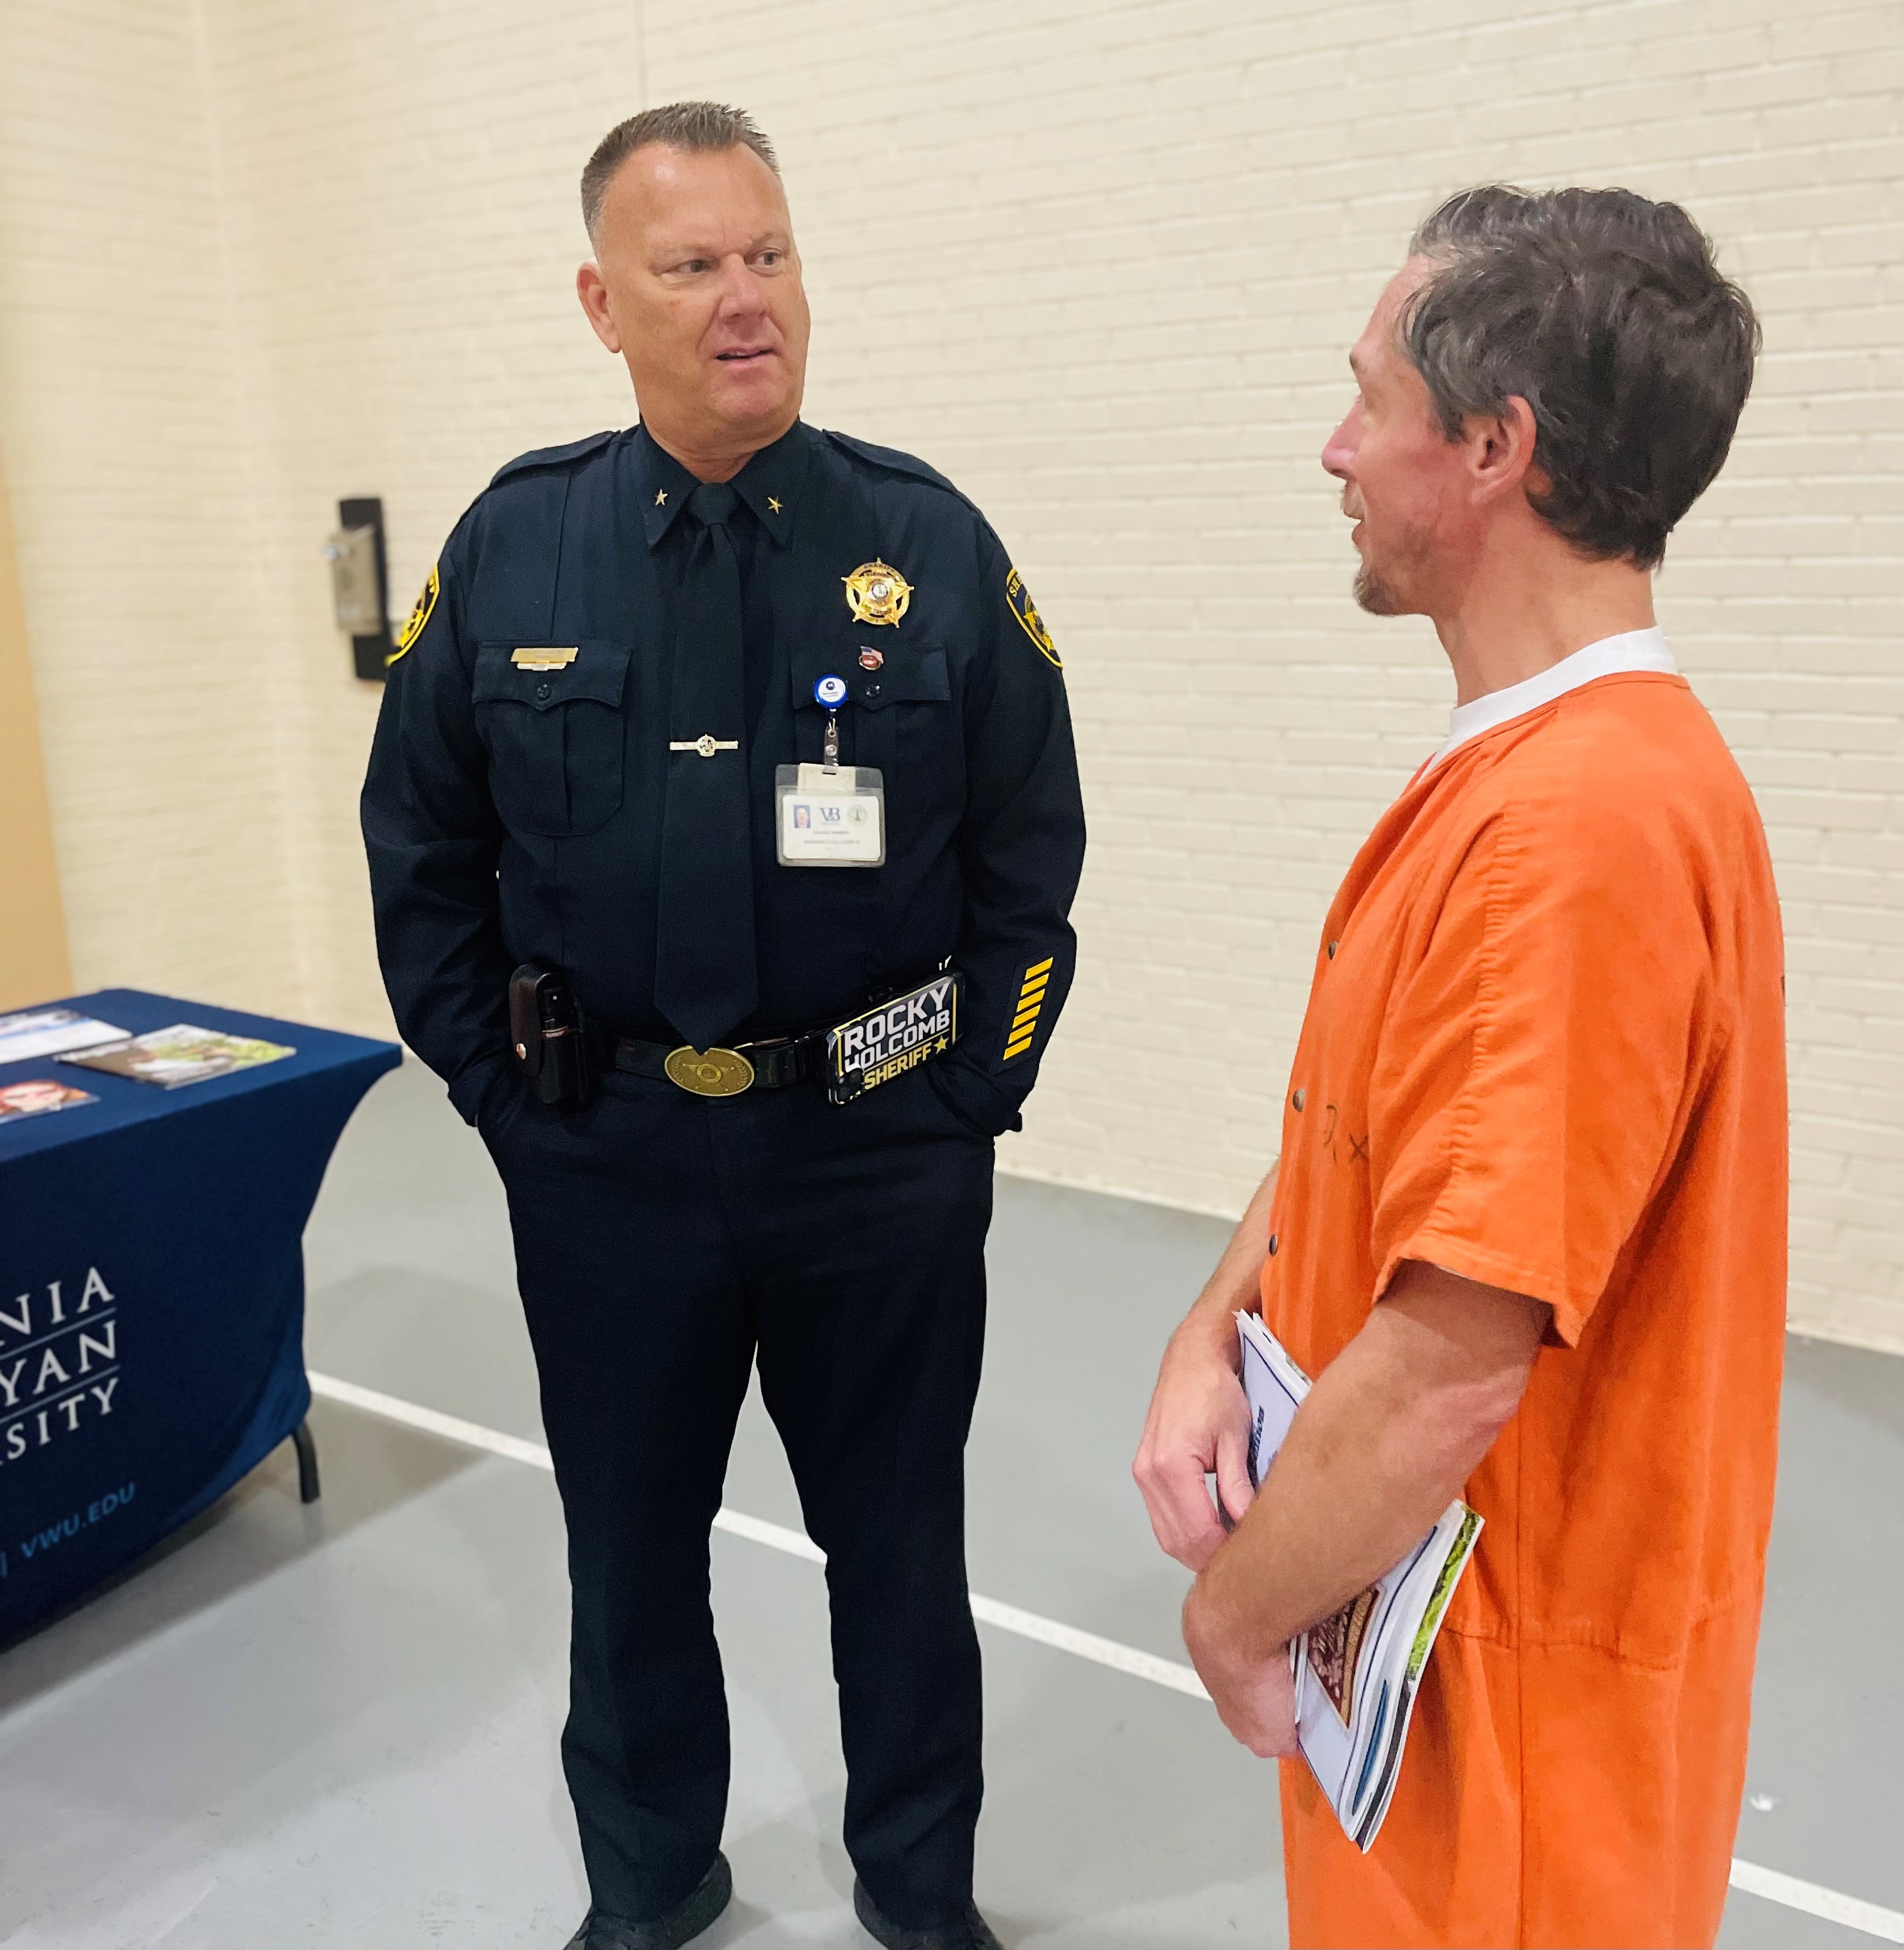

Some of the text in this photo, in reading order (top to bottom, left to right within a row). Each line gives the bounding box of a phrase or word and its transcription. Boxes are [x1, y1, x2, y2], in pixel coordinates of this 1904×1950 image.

[819, 807, 840, 822] VB
[844, 981, 951, 1057] ROCKY
[844, 1009, 950, 1073] HOLCOMB
[864, 1041, 932, 1090] SHERIFF
[0, 1320, 117, 1407] YAN
[0, 1377, 119, 1465] SITY
[21, 1481, 135, 1559] VWU.EDU
